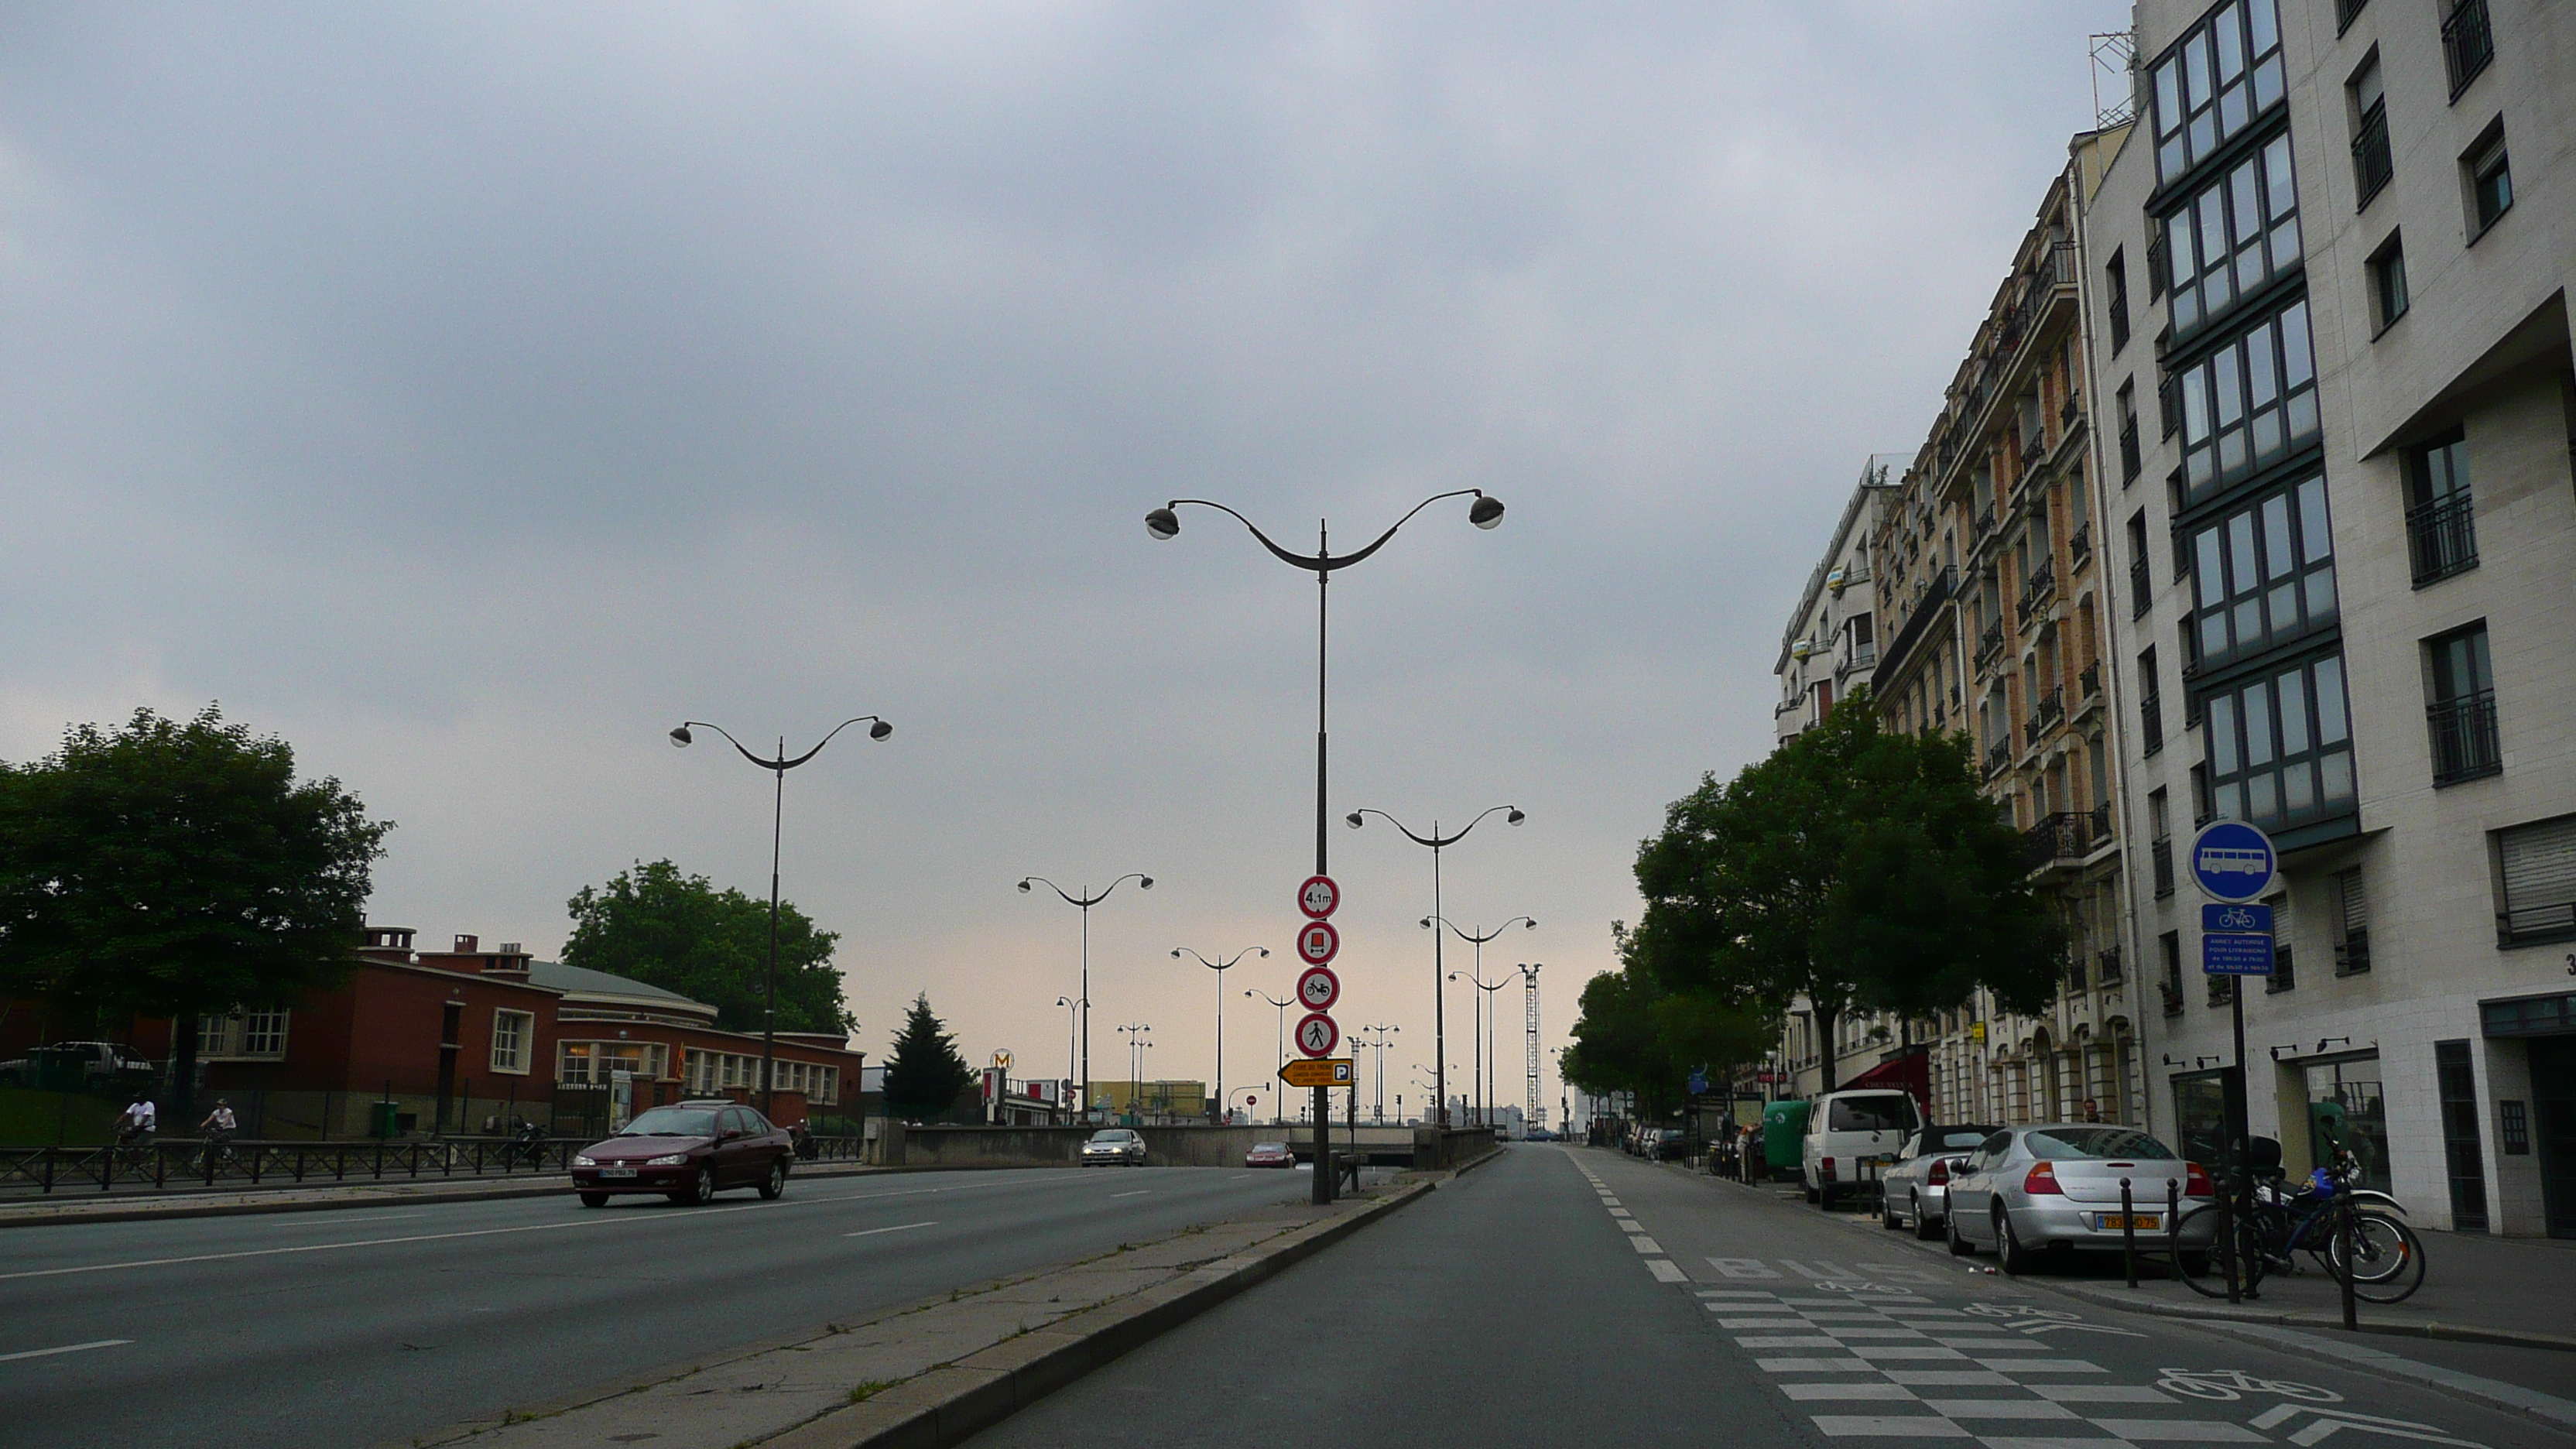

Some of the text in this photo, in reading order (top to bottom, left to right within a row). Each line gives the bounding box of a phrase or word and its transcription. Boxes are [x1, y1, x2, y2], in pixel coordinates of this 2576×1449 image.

[1305, 892, 1331, 903] 4.1m
[995, 1053, 1009, 1068] M
[2105, 1218, 2122, 1228] 783
[2145, 1218, 2157, 1227] 75
[1704, 1256, 1954, 1285] BUS
